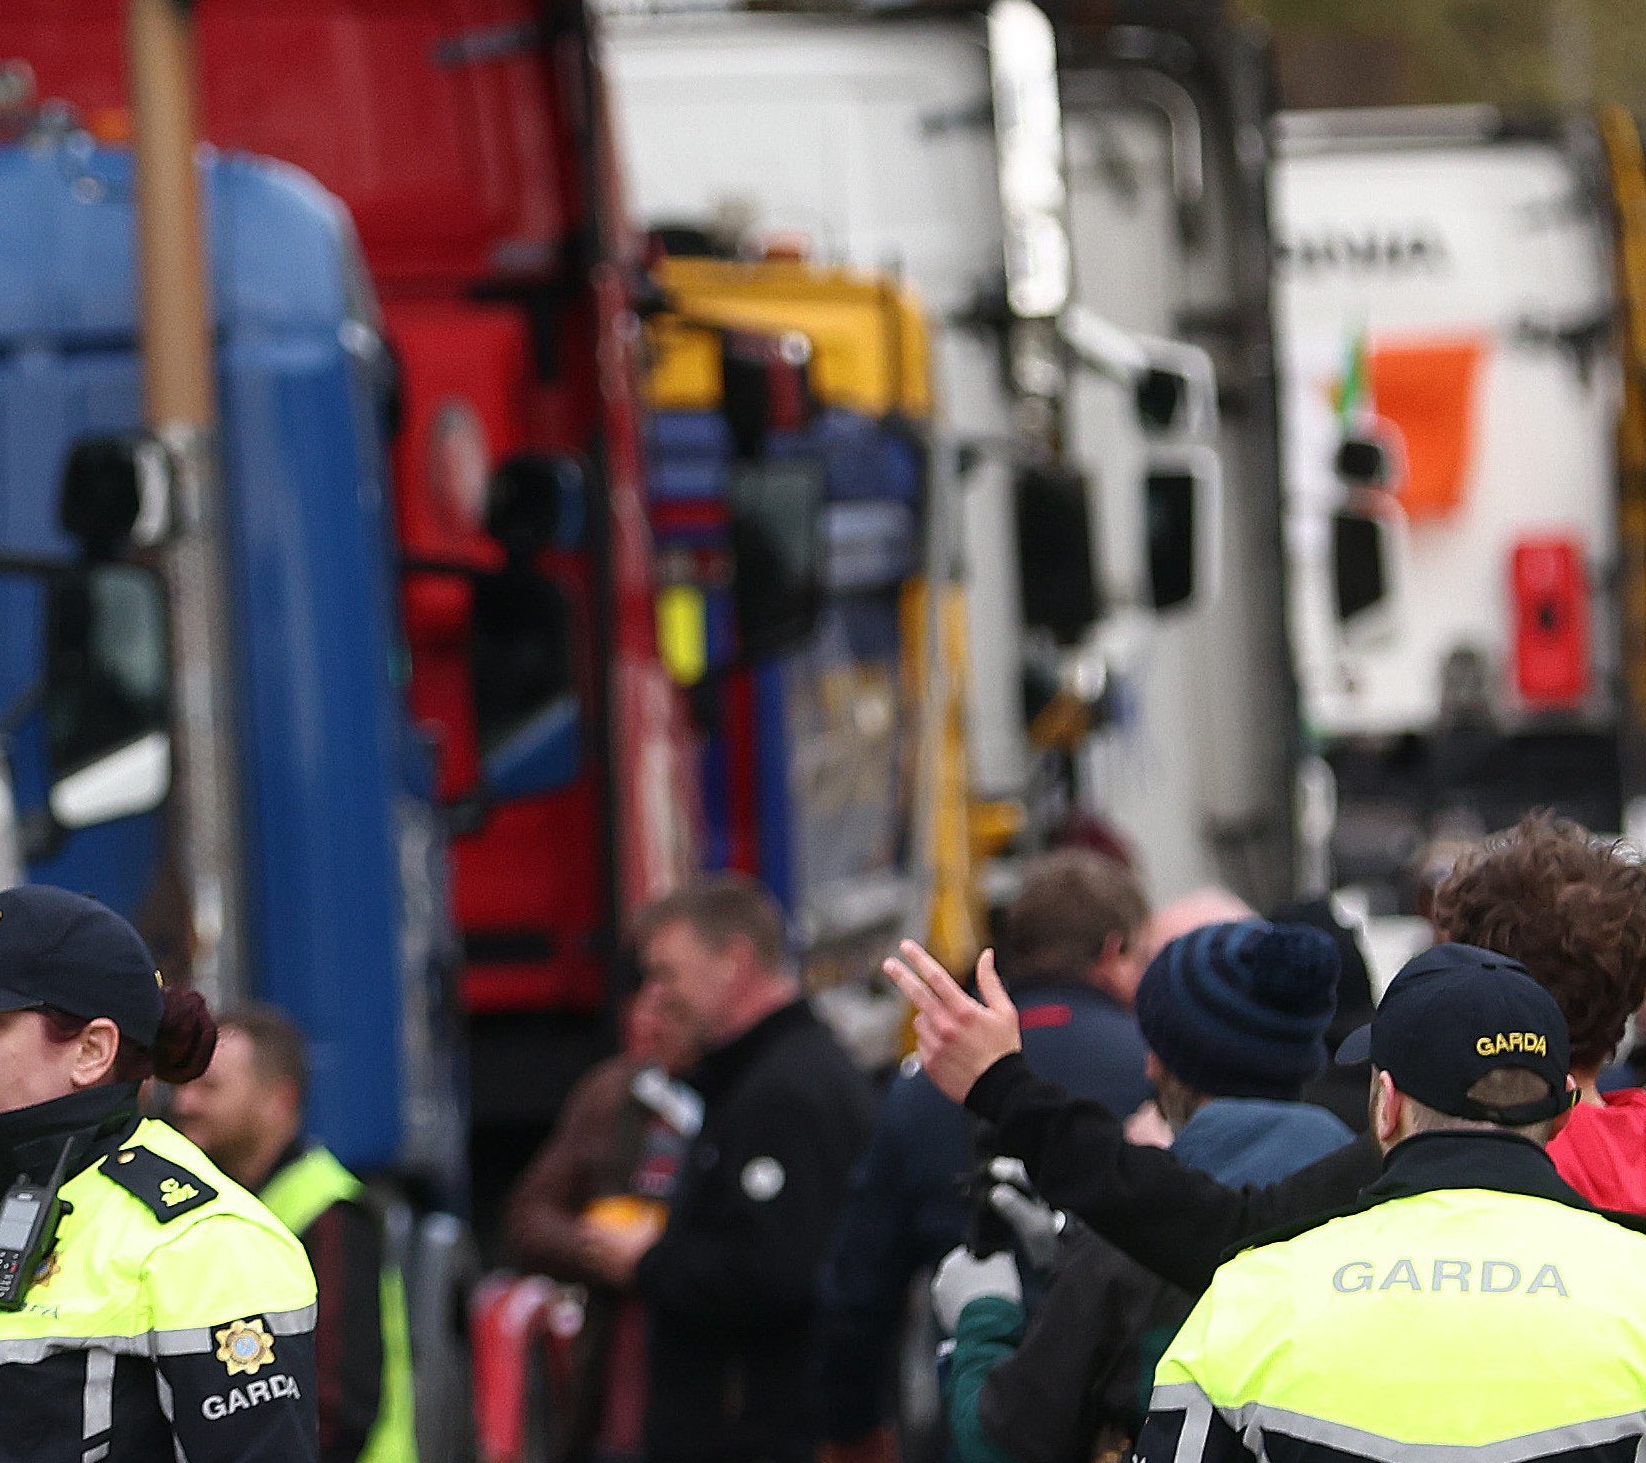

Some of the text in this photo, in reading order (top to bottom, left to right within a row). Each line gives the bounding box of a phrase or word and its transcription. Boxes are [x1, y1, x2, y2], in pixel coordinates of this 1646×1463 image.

[1476, 1032, 1547, 1058] GARDA
[1332, 1259, 1569, 1297] GARDA
[201, 1374, 302, 1421] GARDA
